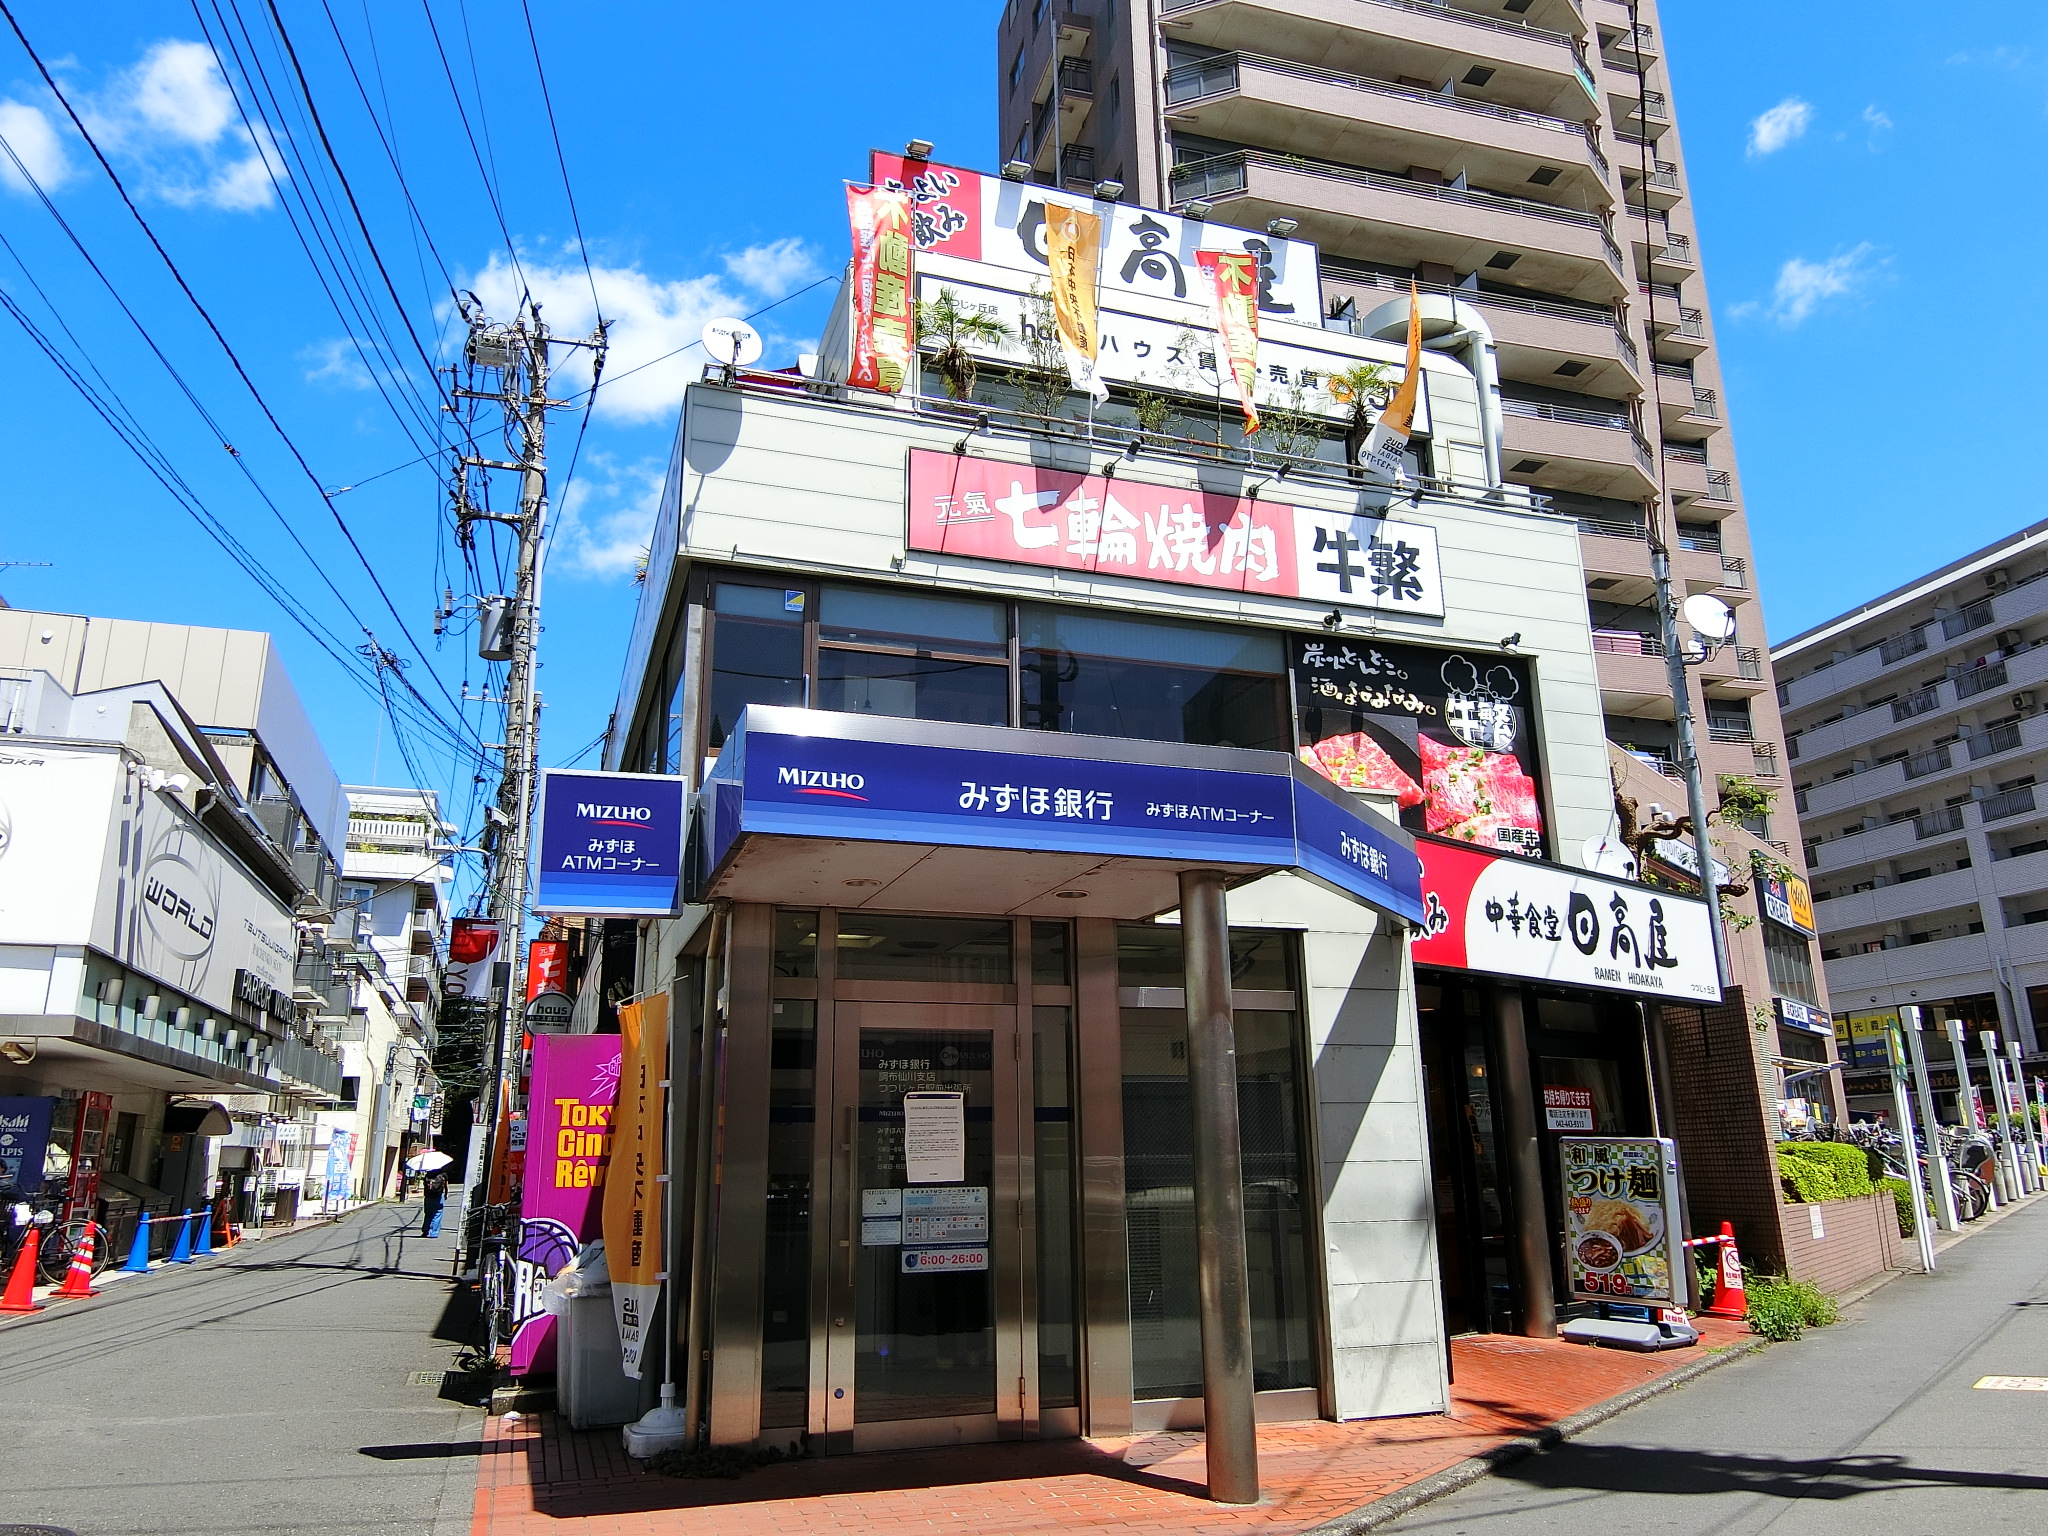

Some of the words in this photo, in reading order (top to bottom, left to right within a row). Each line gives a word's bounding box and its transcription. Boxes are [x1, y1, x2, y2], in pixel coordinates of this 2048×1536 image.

[994, 479, 1279, 582] 七輪焼肉
[1313, 525, 1422, 603] 牛繁
[778, 766, 865, 790] MIZUHO
[576, 802, 651, 821] MIZUHO
[958, 781, 1114, 820] みずほ銀行
[1145, 801, 1276, 823] みずほATMコーナー
[587, 838, 636, 854] みずほ
[1497, 828, 1538, 844] 国産牛
[561, 855, 660, 871] ATMコーナー
[1340, 830, 1388, 881] みずほ銀行
[1485, 890, 1562, 942] 中華食堂
[1767, 896, 1791, 925] CREATE
[1567, 890, 1678, 971] 日高屋
[1594, 966, 1622, 982] RAMEN
[1627, 972, 1664, 989] HIDAKAYA
[241, 969, 272, 1011] PARLOR
[536, 1003, 568, 1015] haus
[879, 1059, 931, 1070] みずほ銀行
[1571, 1146, 1611, 1164] 和風
[1570, 1165, 1659, 1199] つけ麺
